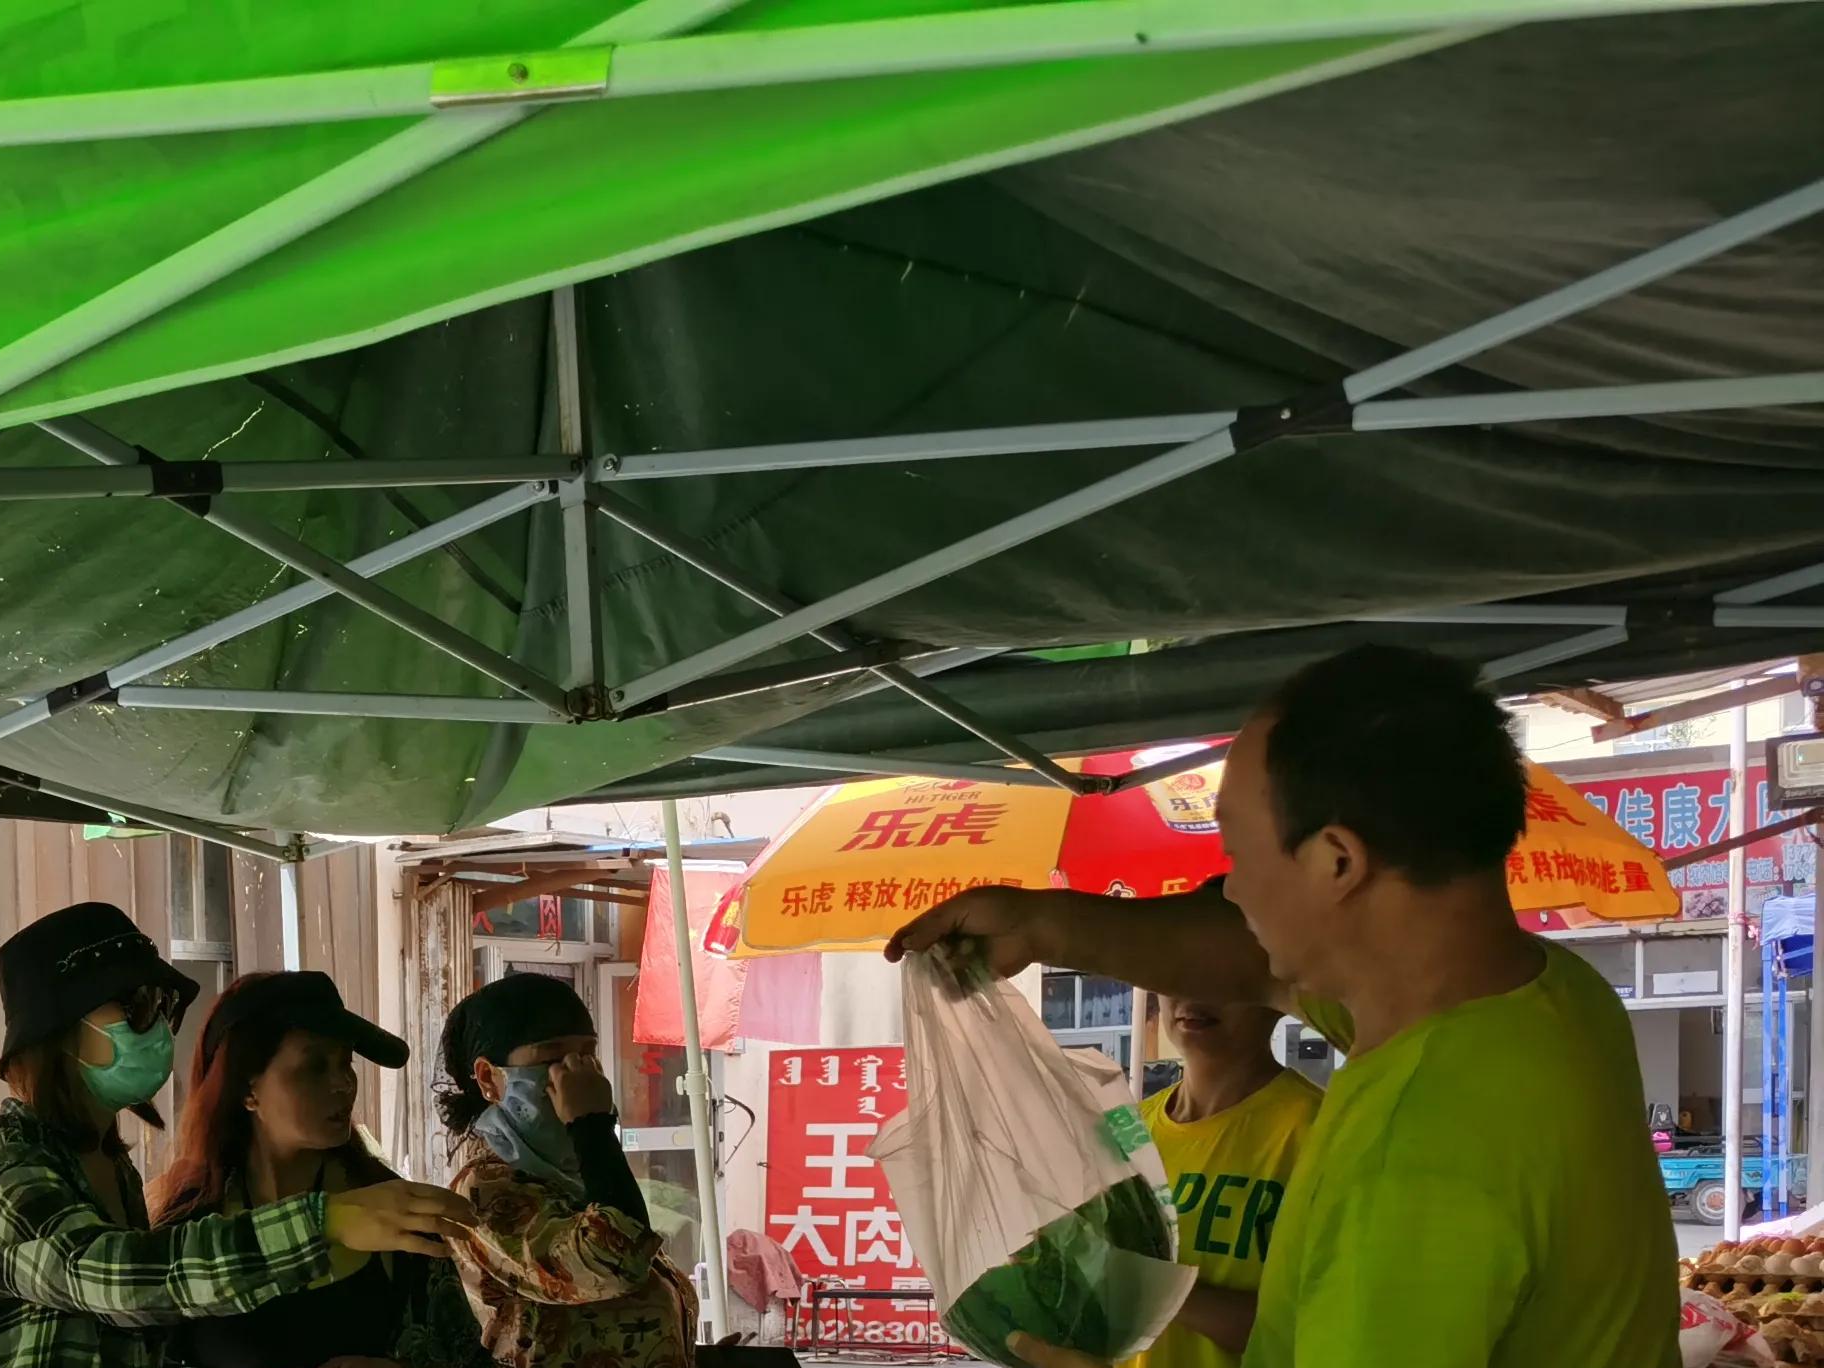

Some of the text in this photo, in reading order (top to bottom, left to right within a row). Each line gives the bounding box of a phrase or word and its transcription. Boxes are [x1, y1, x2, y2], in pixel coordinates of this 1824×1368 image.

[836, 803, 1008, 853] 乐虎
[780, 882, 835, 917] 乐虎
[769, 1205, 923, 1269] 大肉
